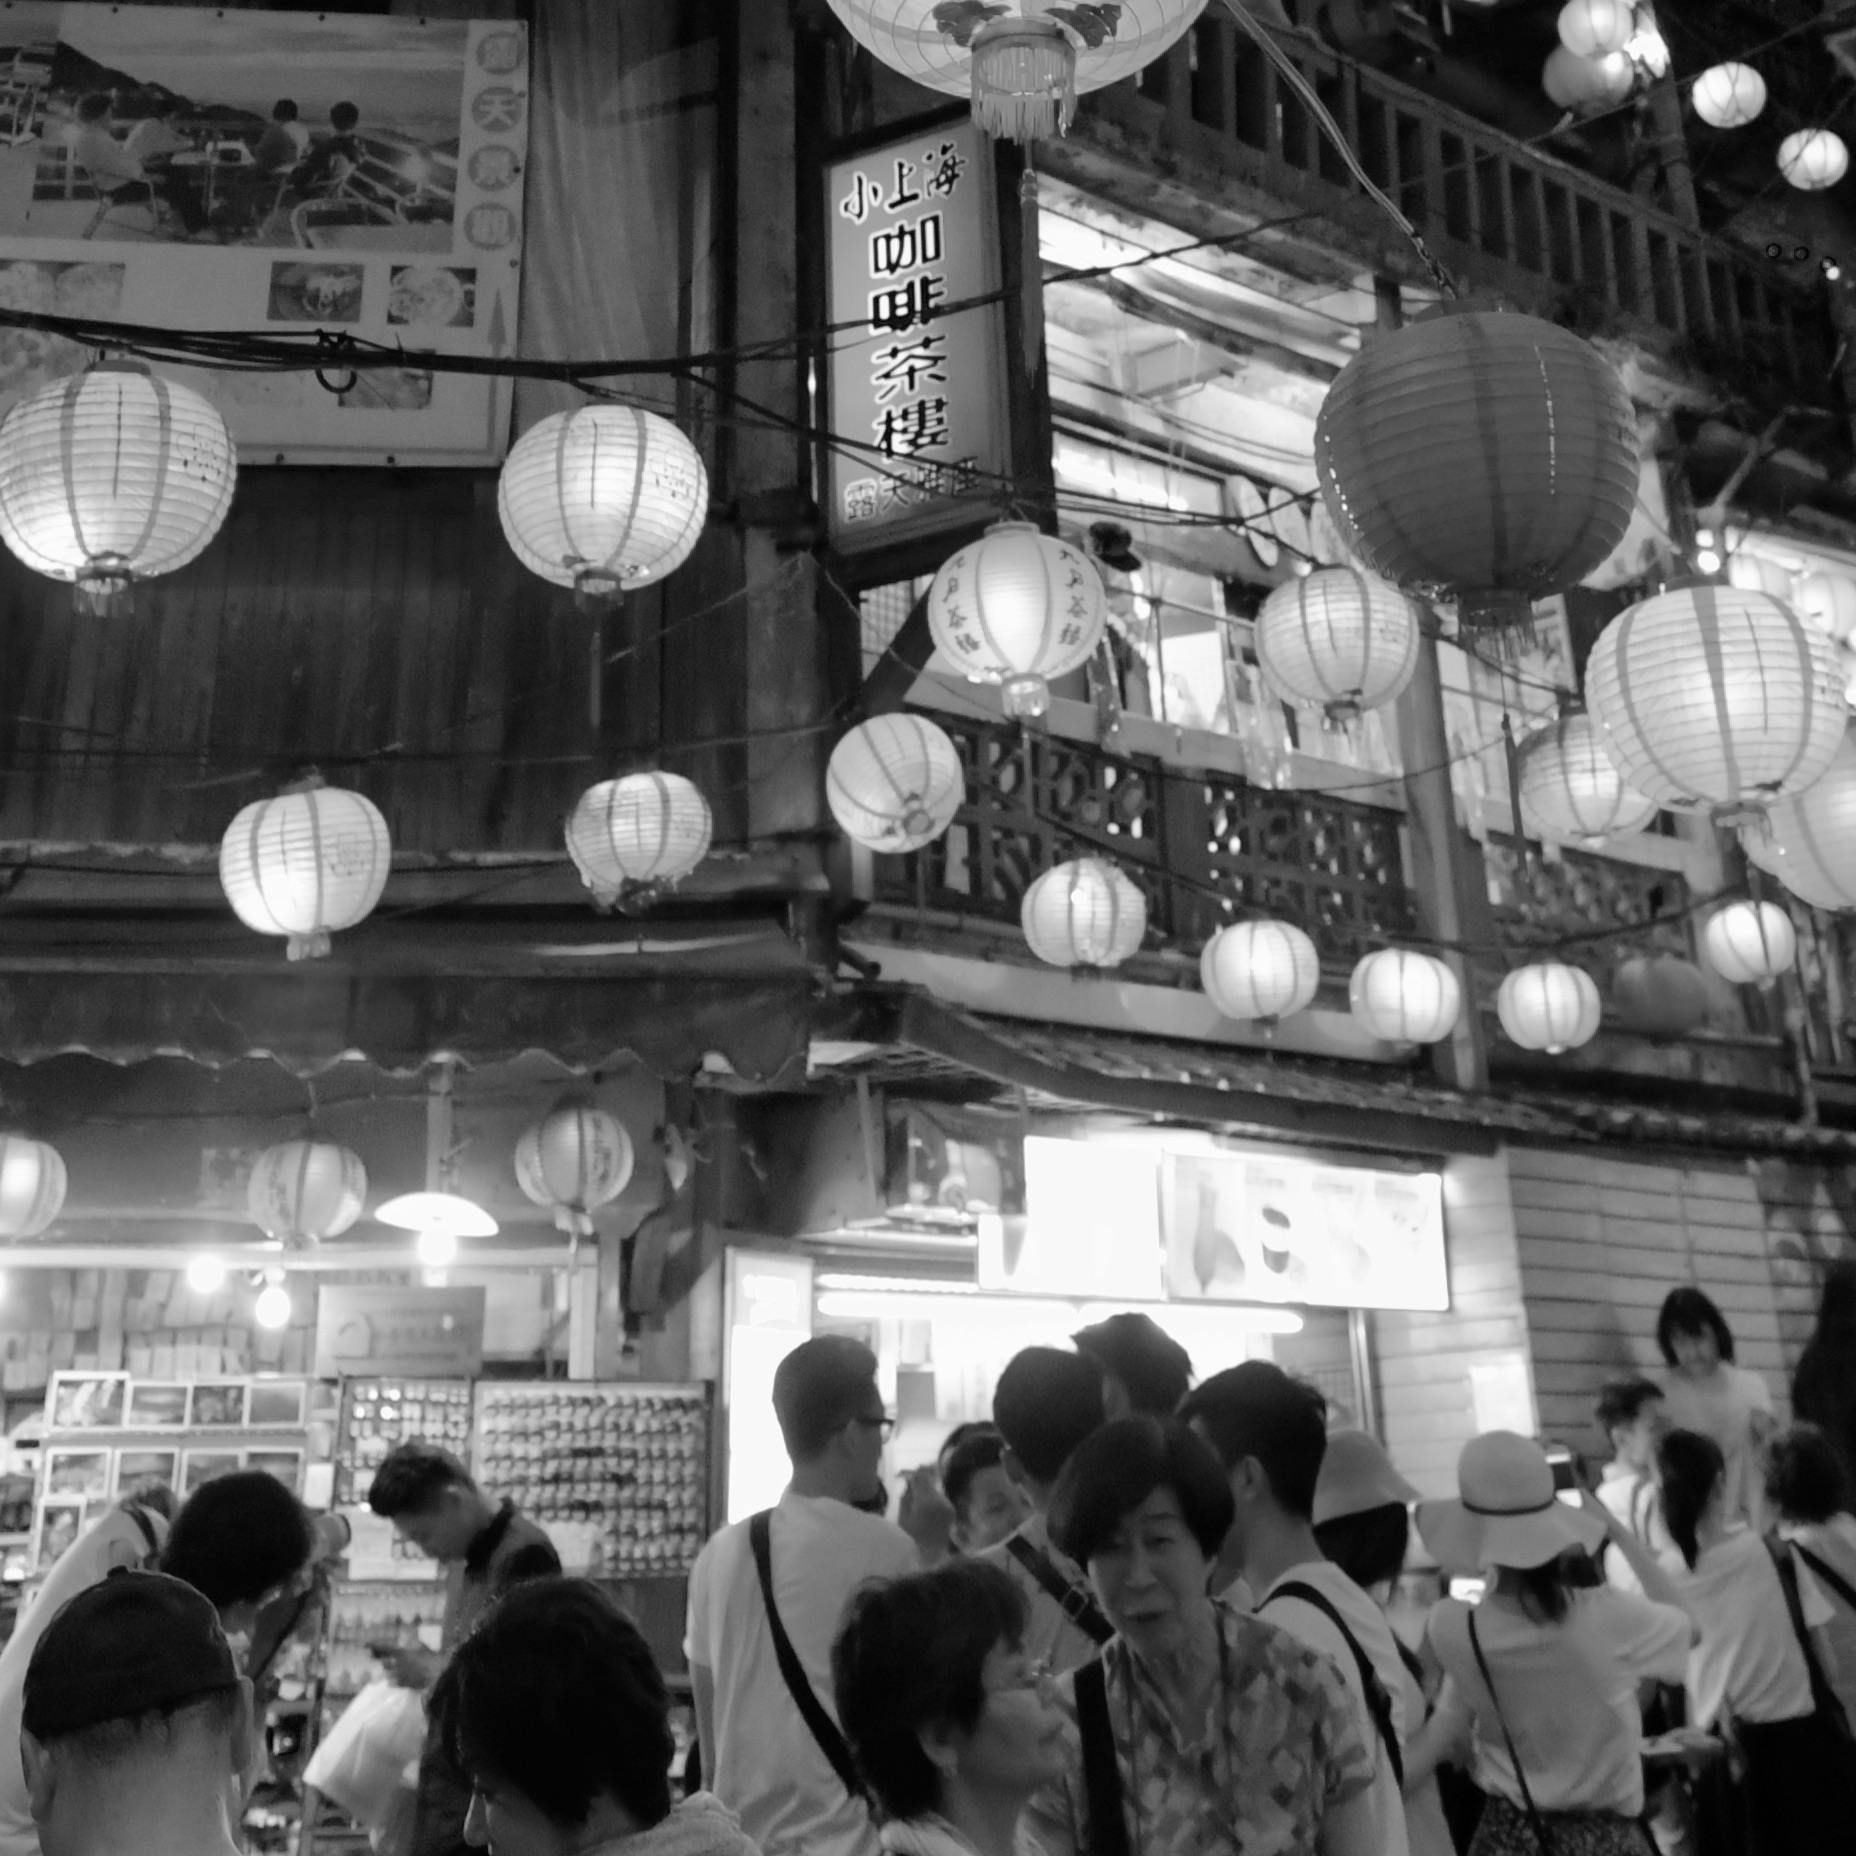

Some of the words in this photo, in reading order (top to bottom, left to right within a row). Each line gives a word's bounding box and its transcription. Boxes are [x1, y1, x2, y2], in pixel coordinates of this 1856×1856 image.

[841, 142, 970, 225] 小上海
[870, 212, 950, 460] 咖啡茶樓
